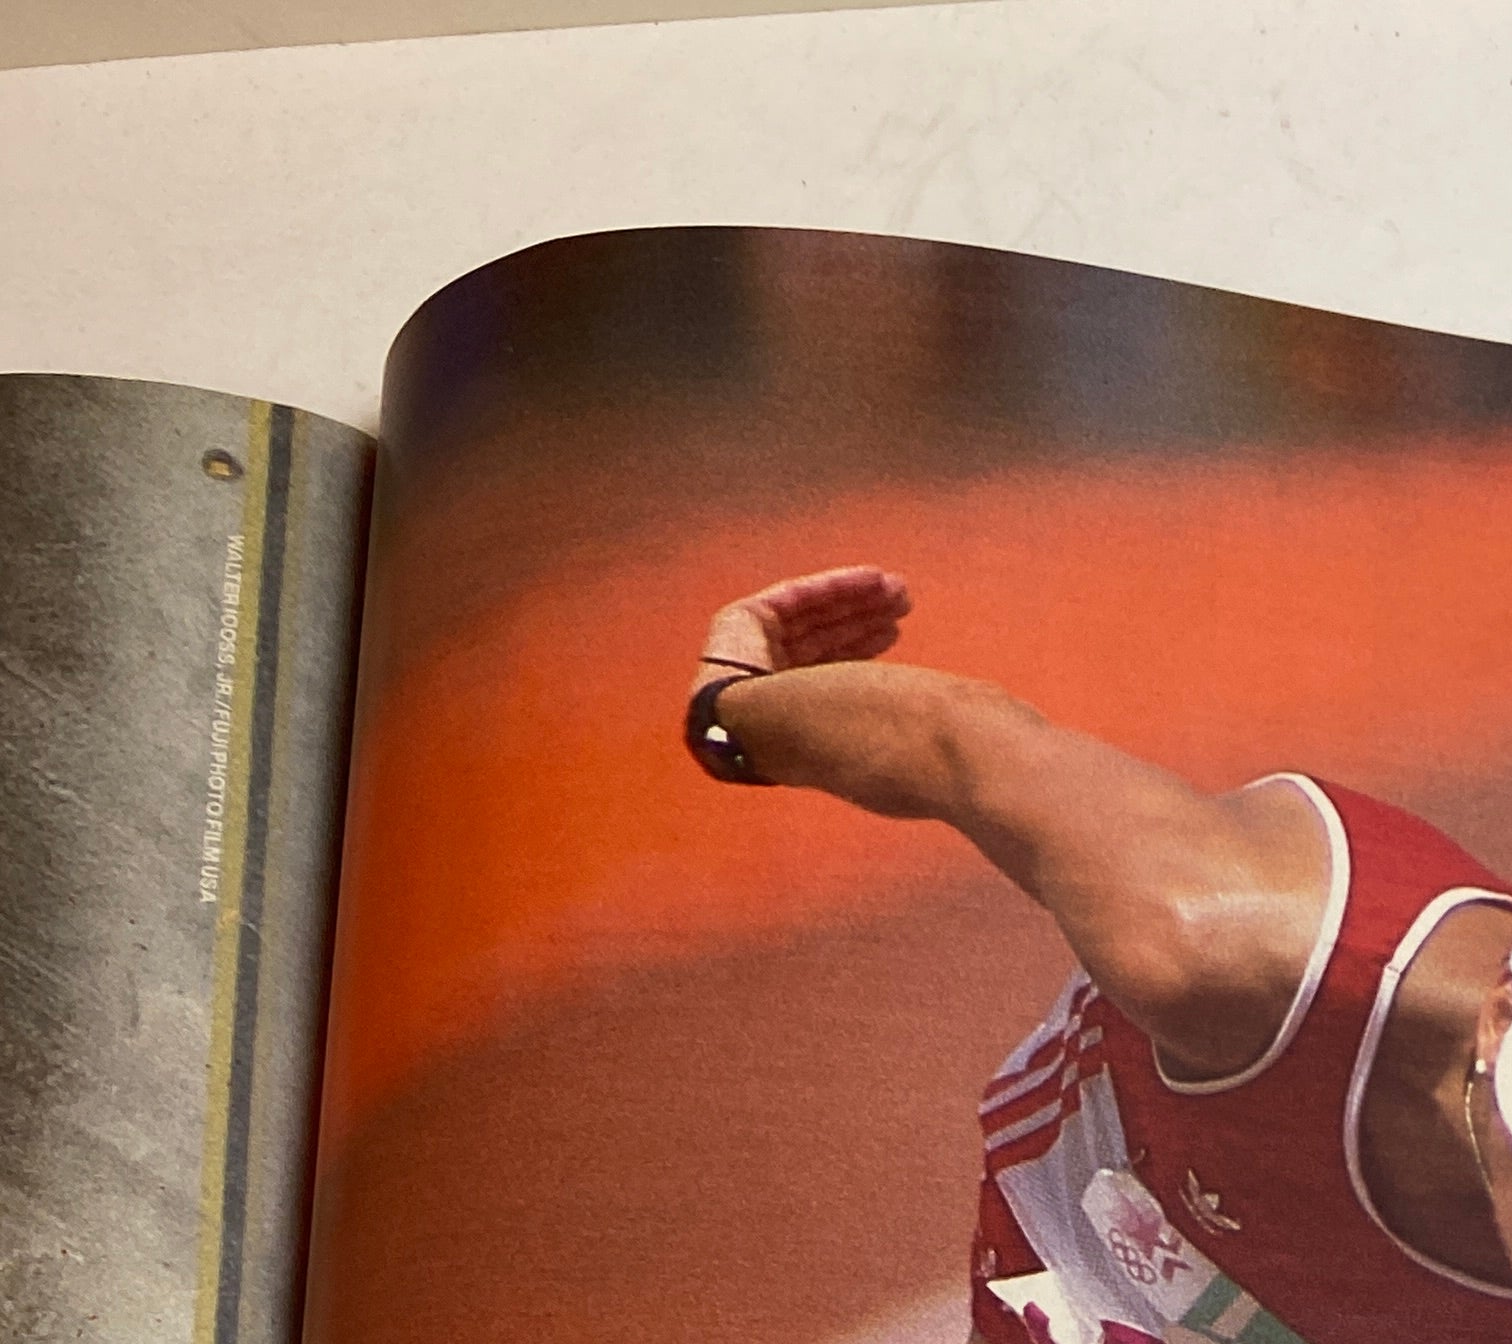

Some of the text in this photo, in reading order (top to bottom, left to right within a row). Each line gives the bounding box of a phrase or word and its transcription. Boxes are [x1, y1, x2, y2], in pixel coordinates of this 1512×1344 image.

[223, 535, 245, 605] WALTER
[205, 751, 228, 817] PHOTO
[202, 818, 223, 863] FILM
[199, 866, 220, 903] USA
